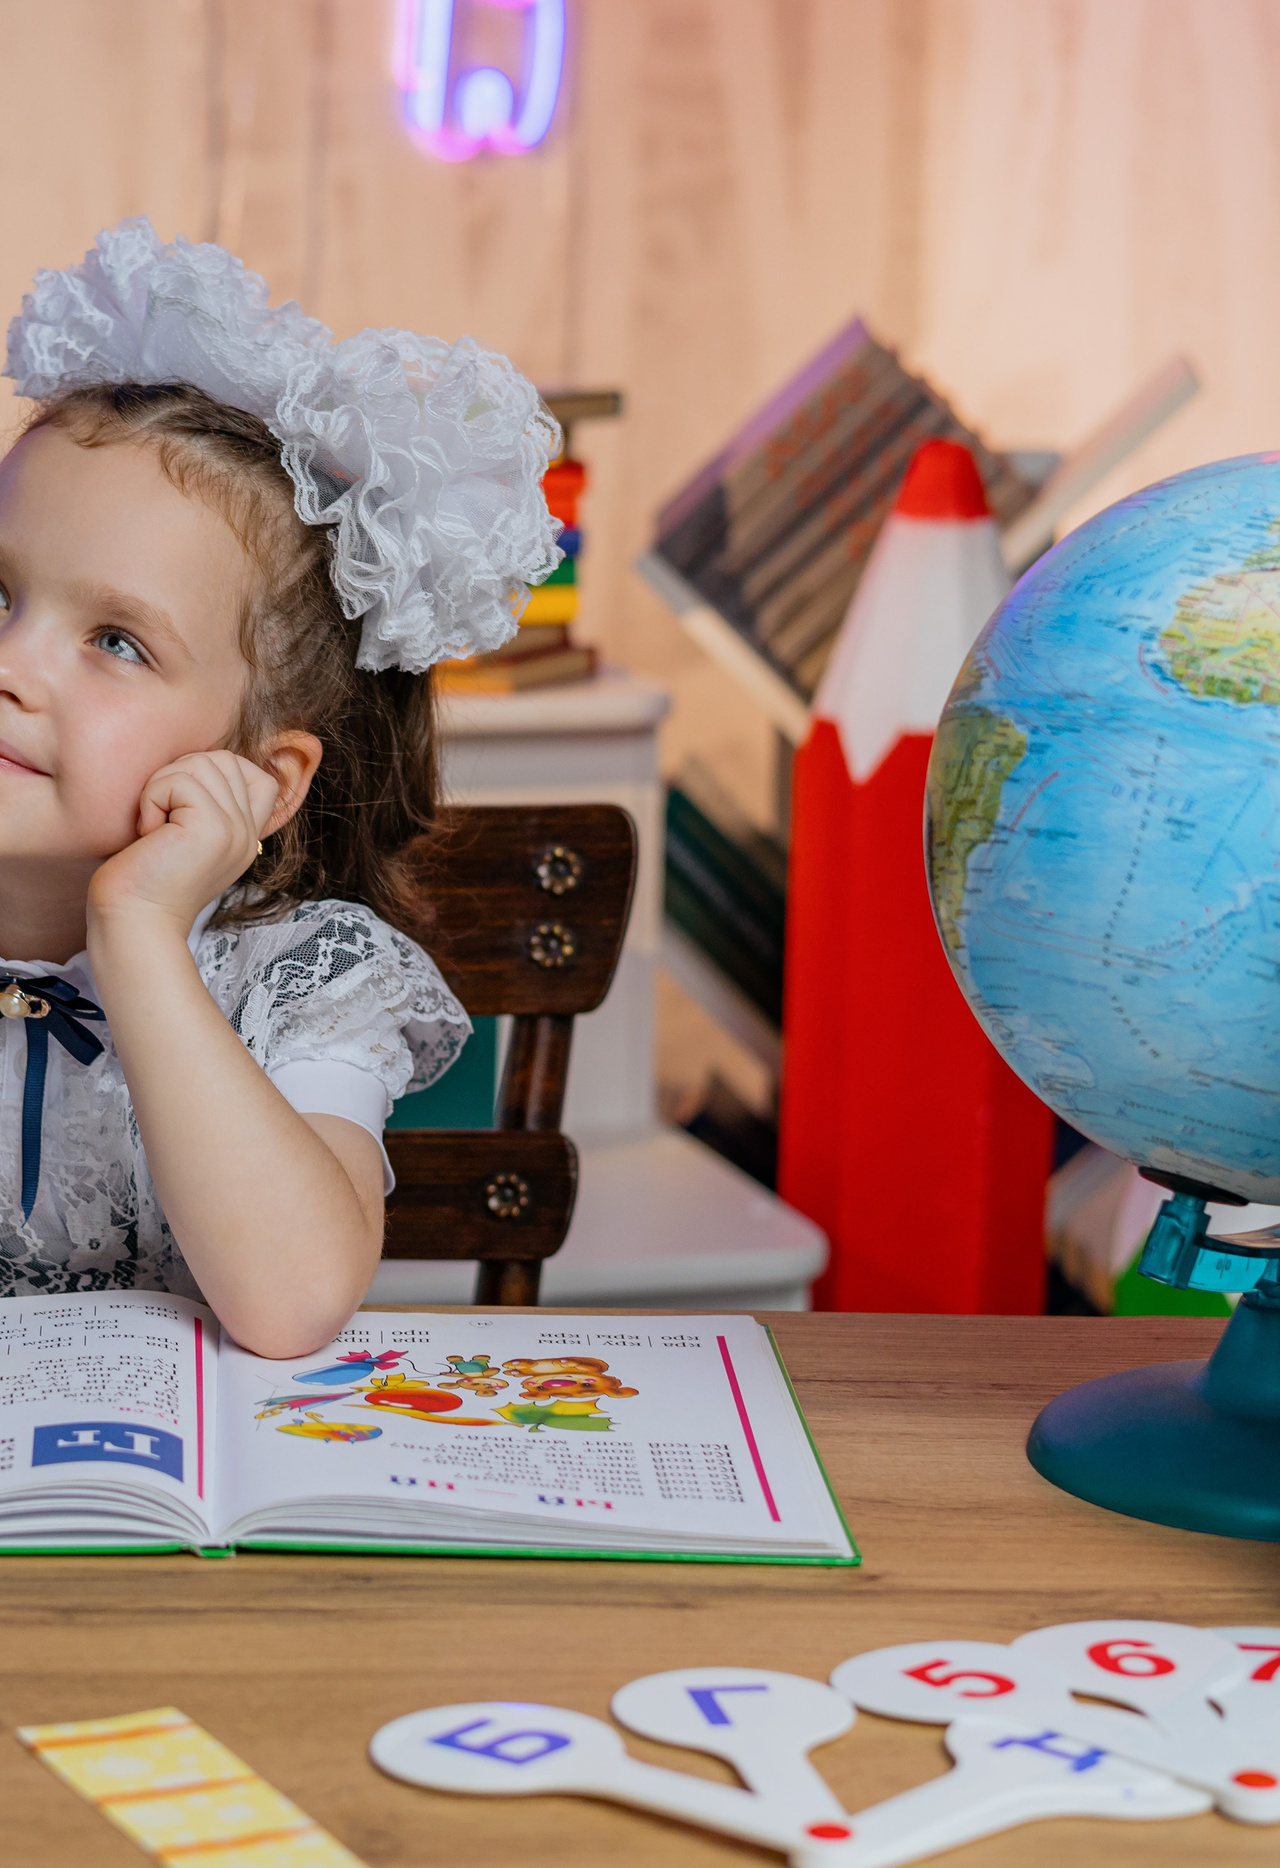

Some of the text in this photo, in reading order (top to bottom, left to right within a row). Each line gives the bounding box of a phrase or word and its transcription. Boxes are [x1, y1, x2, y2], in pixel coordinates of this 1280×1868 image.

[33, 1307, 82, 1316] гном
[22, 1337, 72, 1346] гром
[57, 1430, 160, 1461] Гг
[1085, 1638, 1177, 1679] 6
[900, 1657, 1017, 1699] 5
